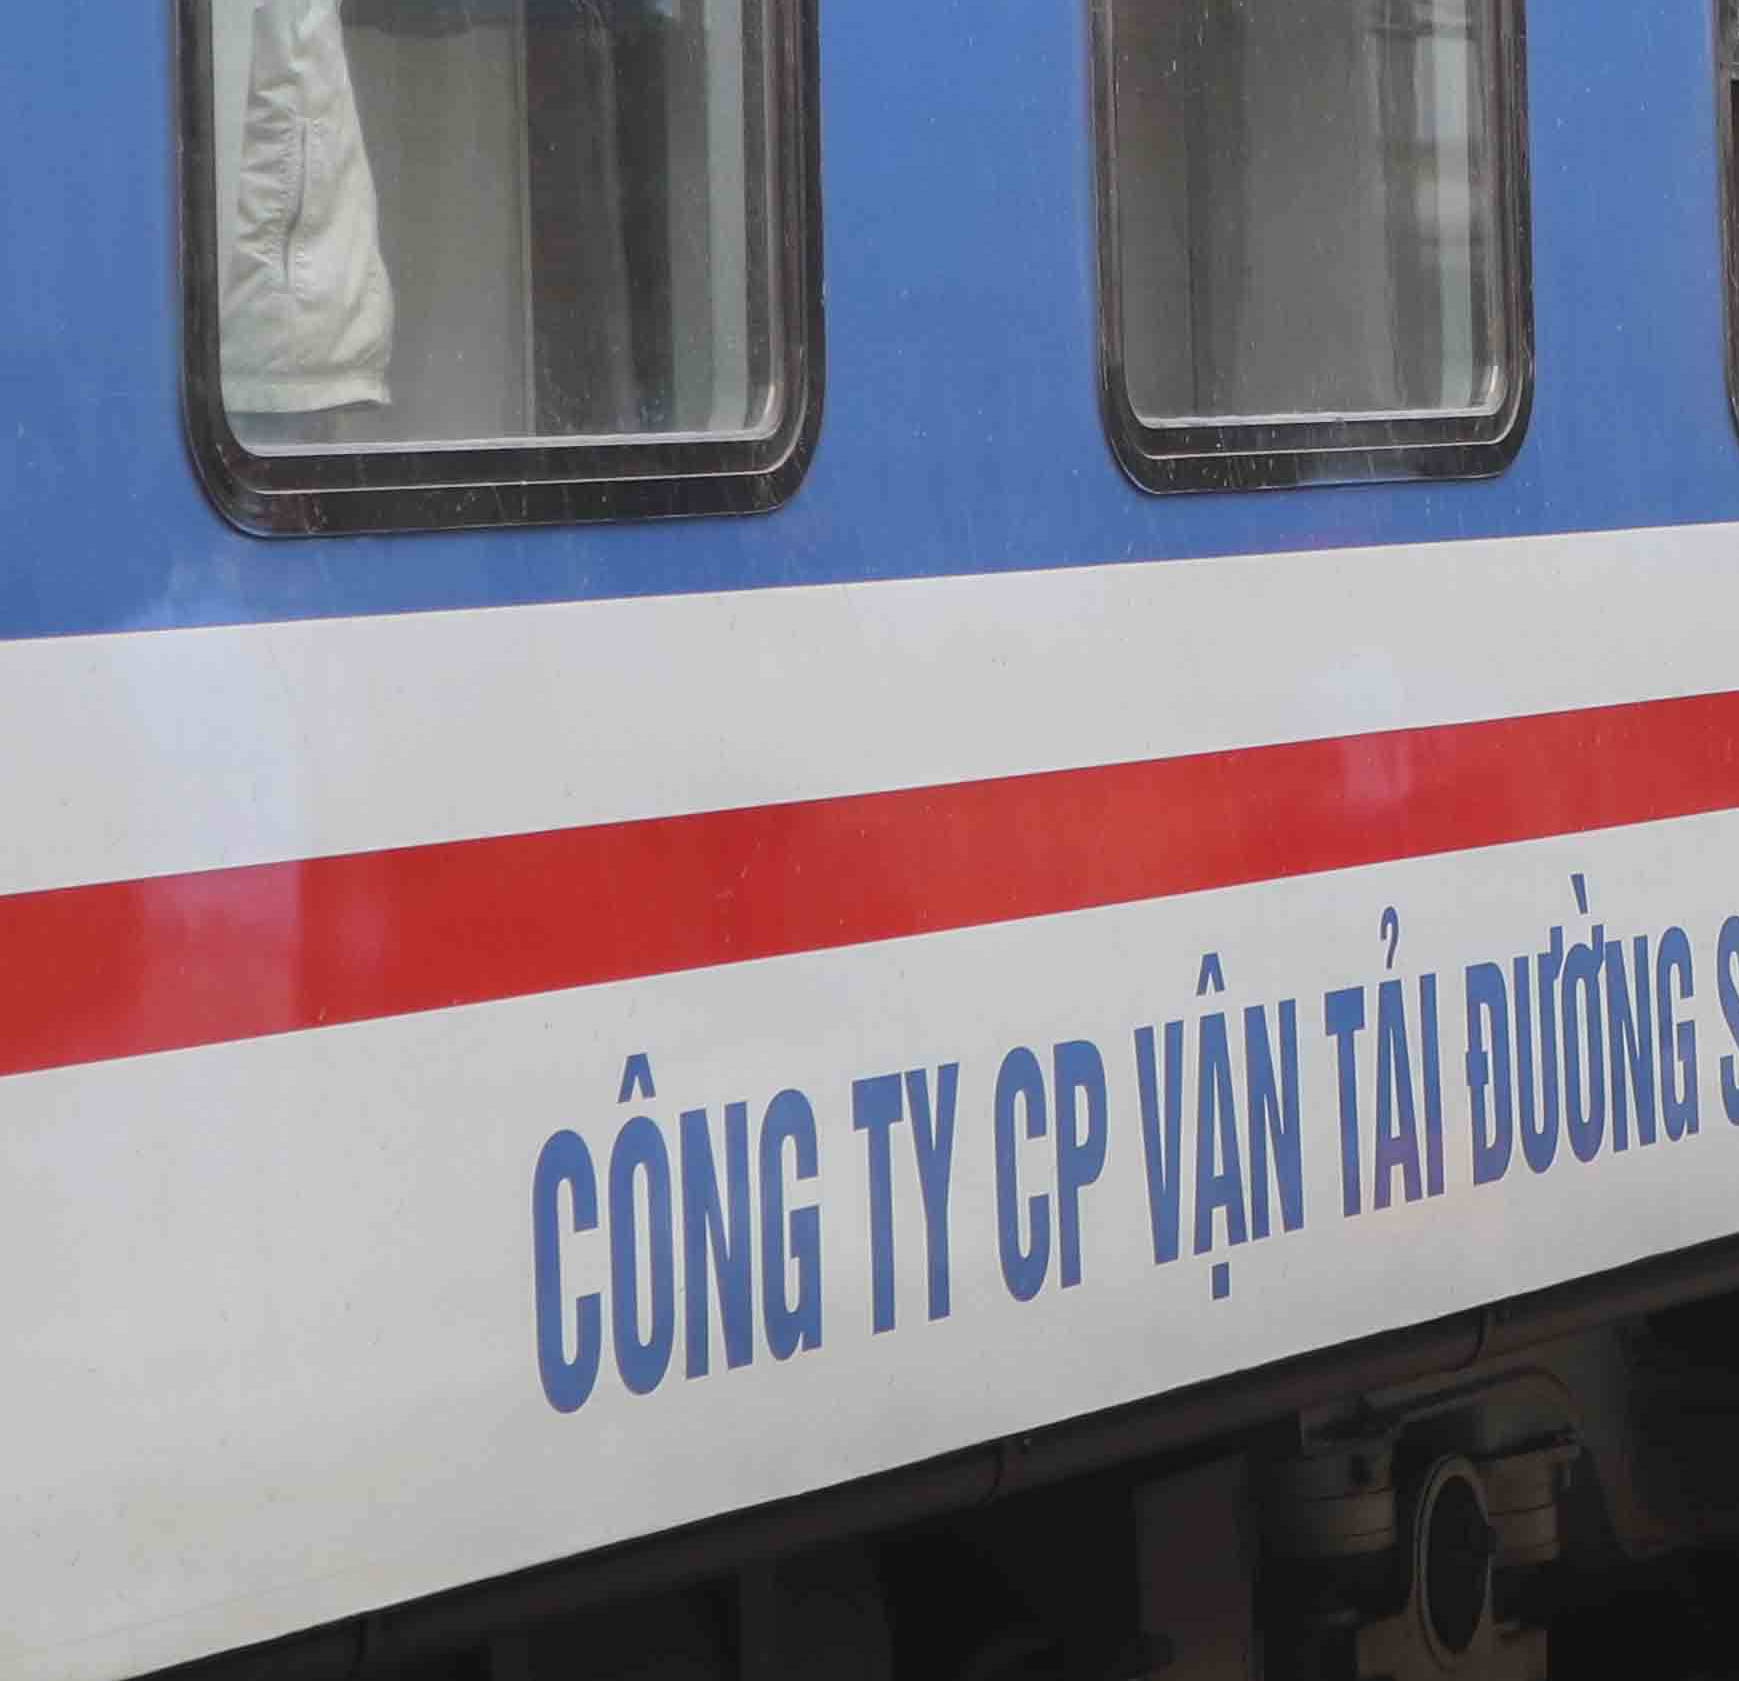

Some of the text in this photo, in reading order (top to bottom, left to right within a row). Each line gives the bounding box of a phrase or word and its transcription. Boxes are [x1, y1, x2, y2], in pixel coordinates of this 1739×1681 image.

[532, 1051, 824, 1411] CÔNG
[850, 1060, 962, 1333] TY
[994, 1038, 1110, 1302] CP
[1133, 950, 1304, 1298] VẬN
[1325, 907, 1444, 1217] TẢI
[1462, 873, 1700, 1186] ĐƯỜNG
